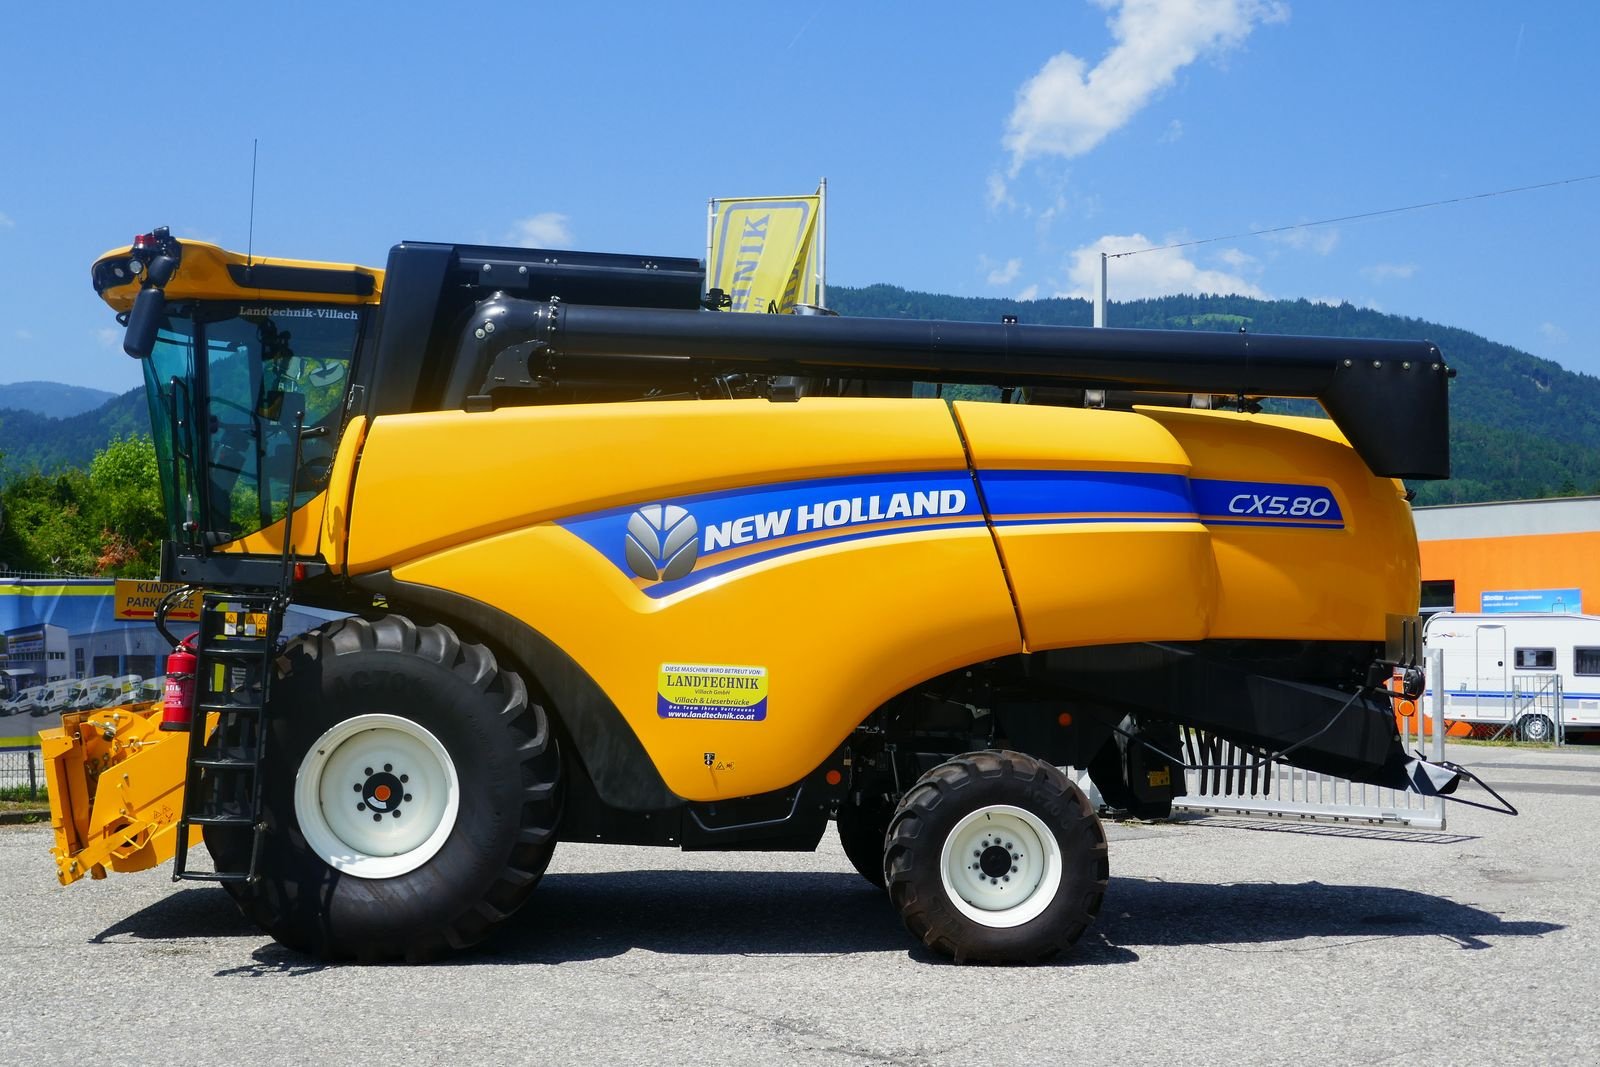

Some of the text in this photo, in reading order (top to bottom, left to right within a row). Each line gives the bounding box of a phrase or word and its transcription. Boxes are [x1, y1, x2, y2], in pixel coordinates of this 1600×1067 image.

[239, 306, 358, 320] Landtechnik-Villach
[1228, 494, 1331, 517] CX5.80
[704, 489, 966, 552] NEW HOLLAND
[126, 596, 195, 609] PARKZE
[667, 675, 759, 689] LANDTECHNIK
[705, 698, 750, 706] Lieserbrücke
[668, 711, 755, 720] www.landtechnik.co.at
